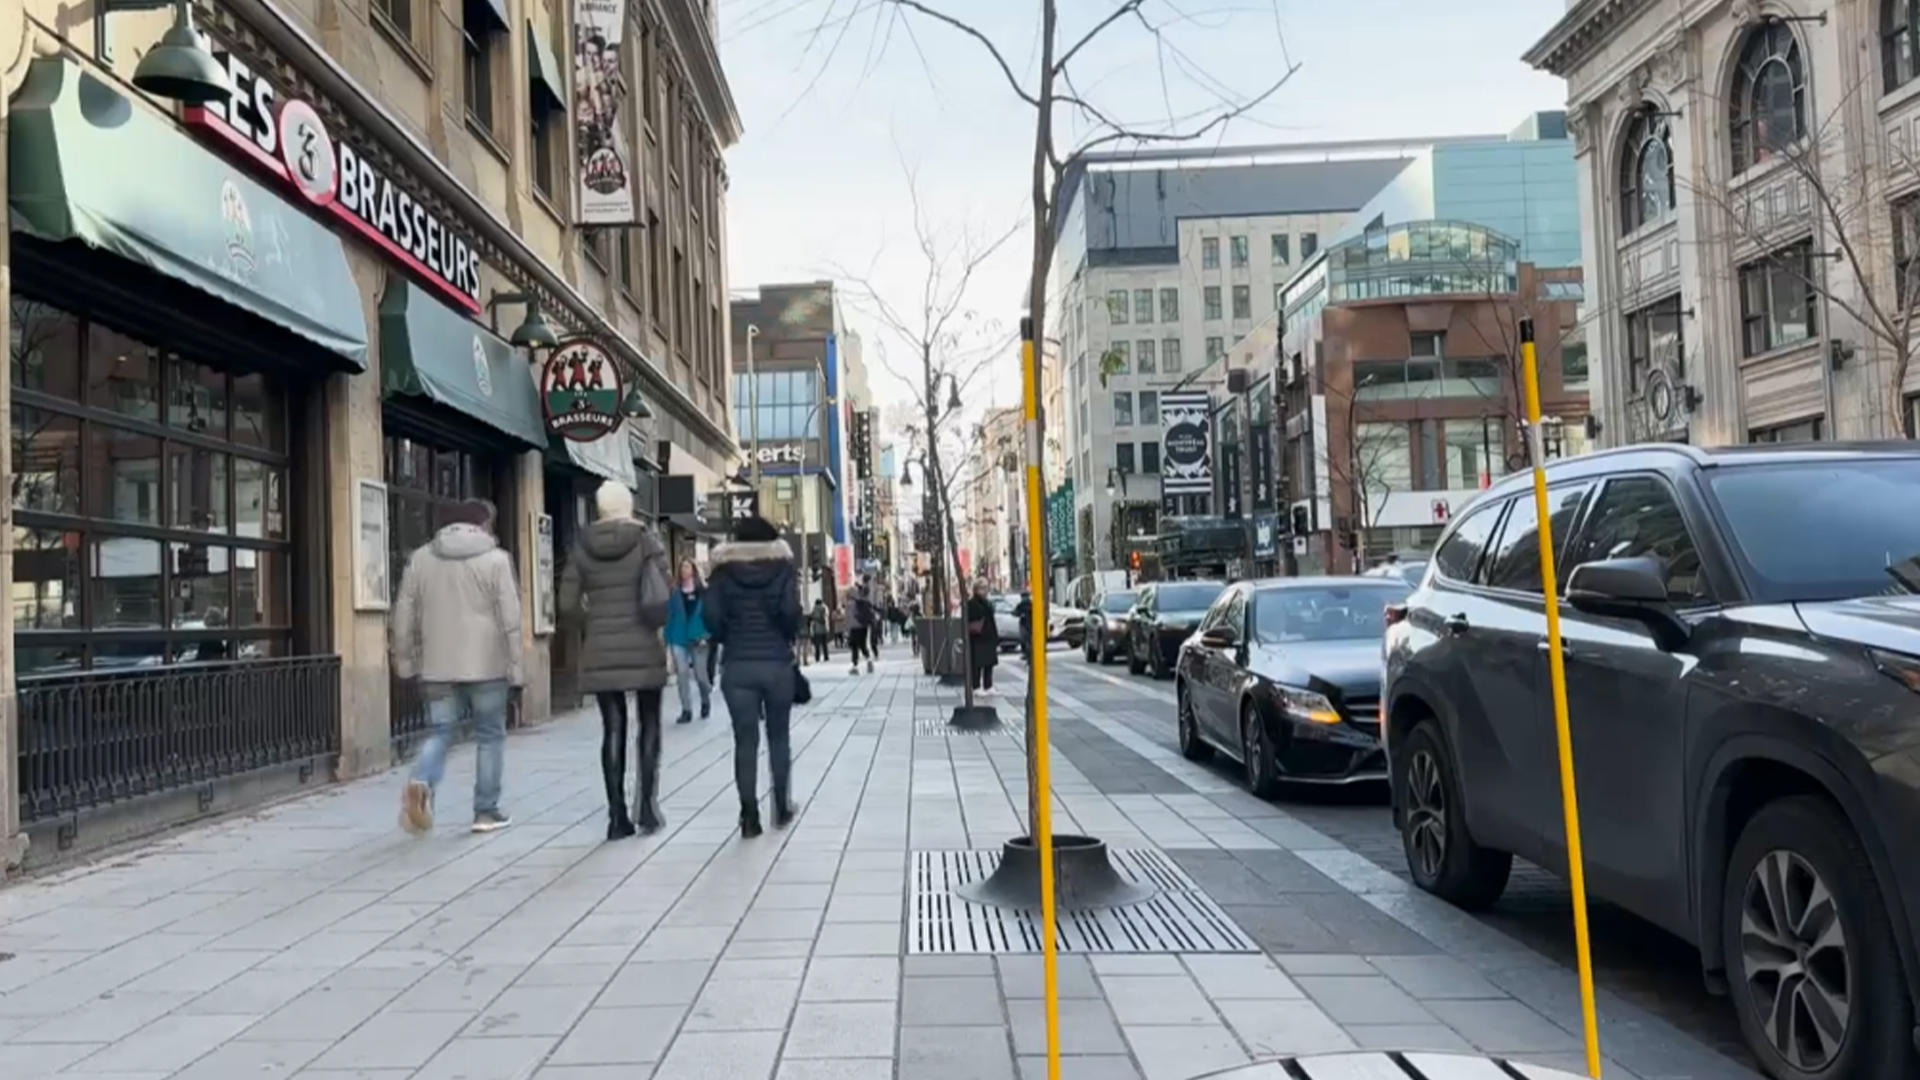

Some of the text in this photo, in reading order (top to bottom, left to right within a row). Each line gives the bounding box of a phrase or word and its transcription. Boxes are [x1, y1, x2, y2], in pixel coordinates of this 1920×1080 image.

[298, 122, 319, 181] 3
[340, 142, 479, 300] BRASSEURS
[551, 413, 613, 428] BRASSEURS
